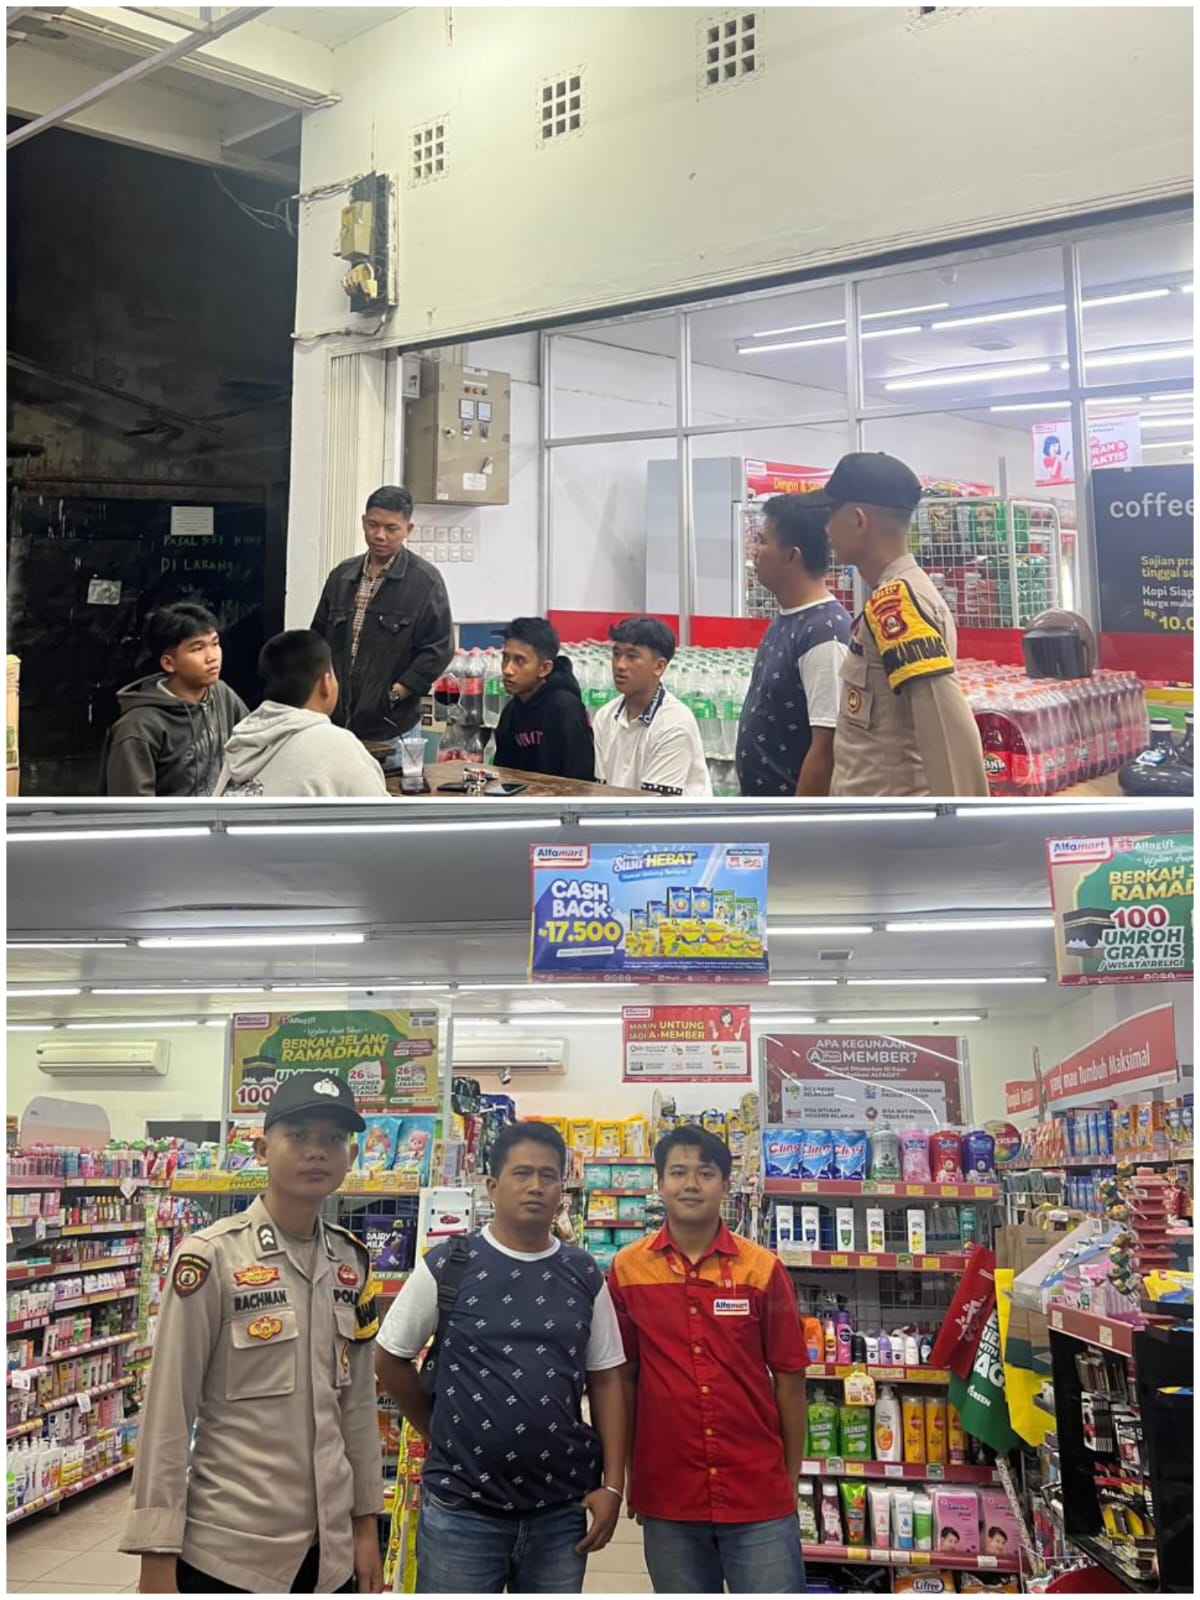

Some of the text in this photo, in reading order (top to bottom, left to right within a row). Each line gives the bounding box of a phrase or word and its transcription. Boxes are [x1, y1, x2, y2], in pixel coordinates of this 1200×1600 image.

[1110, 492, 1194, 518] coffee
[1141, 555, 1175, 568] Sajian
[1142, 567, 1180, 580] tinggal
[1142, 586, 1194, 599] Kopi Siap
[1143, 599, 1169, 609] Harga
[1143, 608, 1157, 619] Rp
[537, 848, 584, 857] Alfamart
[1053, 842, 1105, 852] Alfamart
[645, 852, 695, 868] HEBAT
[1109, 865, 1185, 885] BERKAH
[551, 879, 608, 900] CASH
[552, 900, 607, 918] BACK
[1111, 906, 1168, 929] 100
[1103, 928, 1183, 946] UMROH
[1105, 944, 1183, 961] GRATIS
[1150, 959, 1184, 968] RELIGI
[659, 1020, 705, 1030] UNTUNG
[282, 1033, 389, 1049] BERKAH JELANG
[816, 1040, 907, 1049] APA KEGUNAAN
[282, 1044, 386, 1061] RAMADHAN
[843, 1051, 918, 1063] MEMBER?
[1079, 1059, 1108, 1085] Tumbuh
[1109, 1041, 1151, 1076] Maksimal
[350, 1070, 364, 1080] 26
[237, 1086, 274, 1104] 100
[366, 1232, 390, 1241] DAIRY
[367, 1240, 385, 1249] MILK
[234, 1289, 288, 1311] RACHMAN
[716, 1301, 748, 1309] Alfamart
[915, 1580, 941, 1591] Lifree
